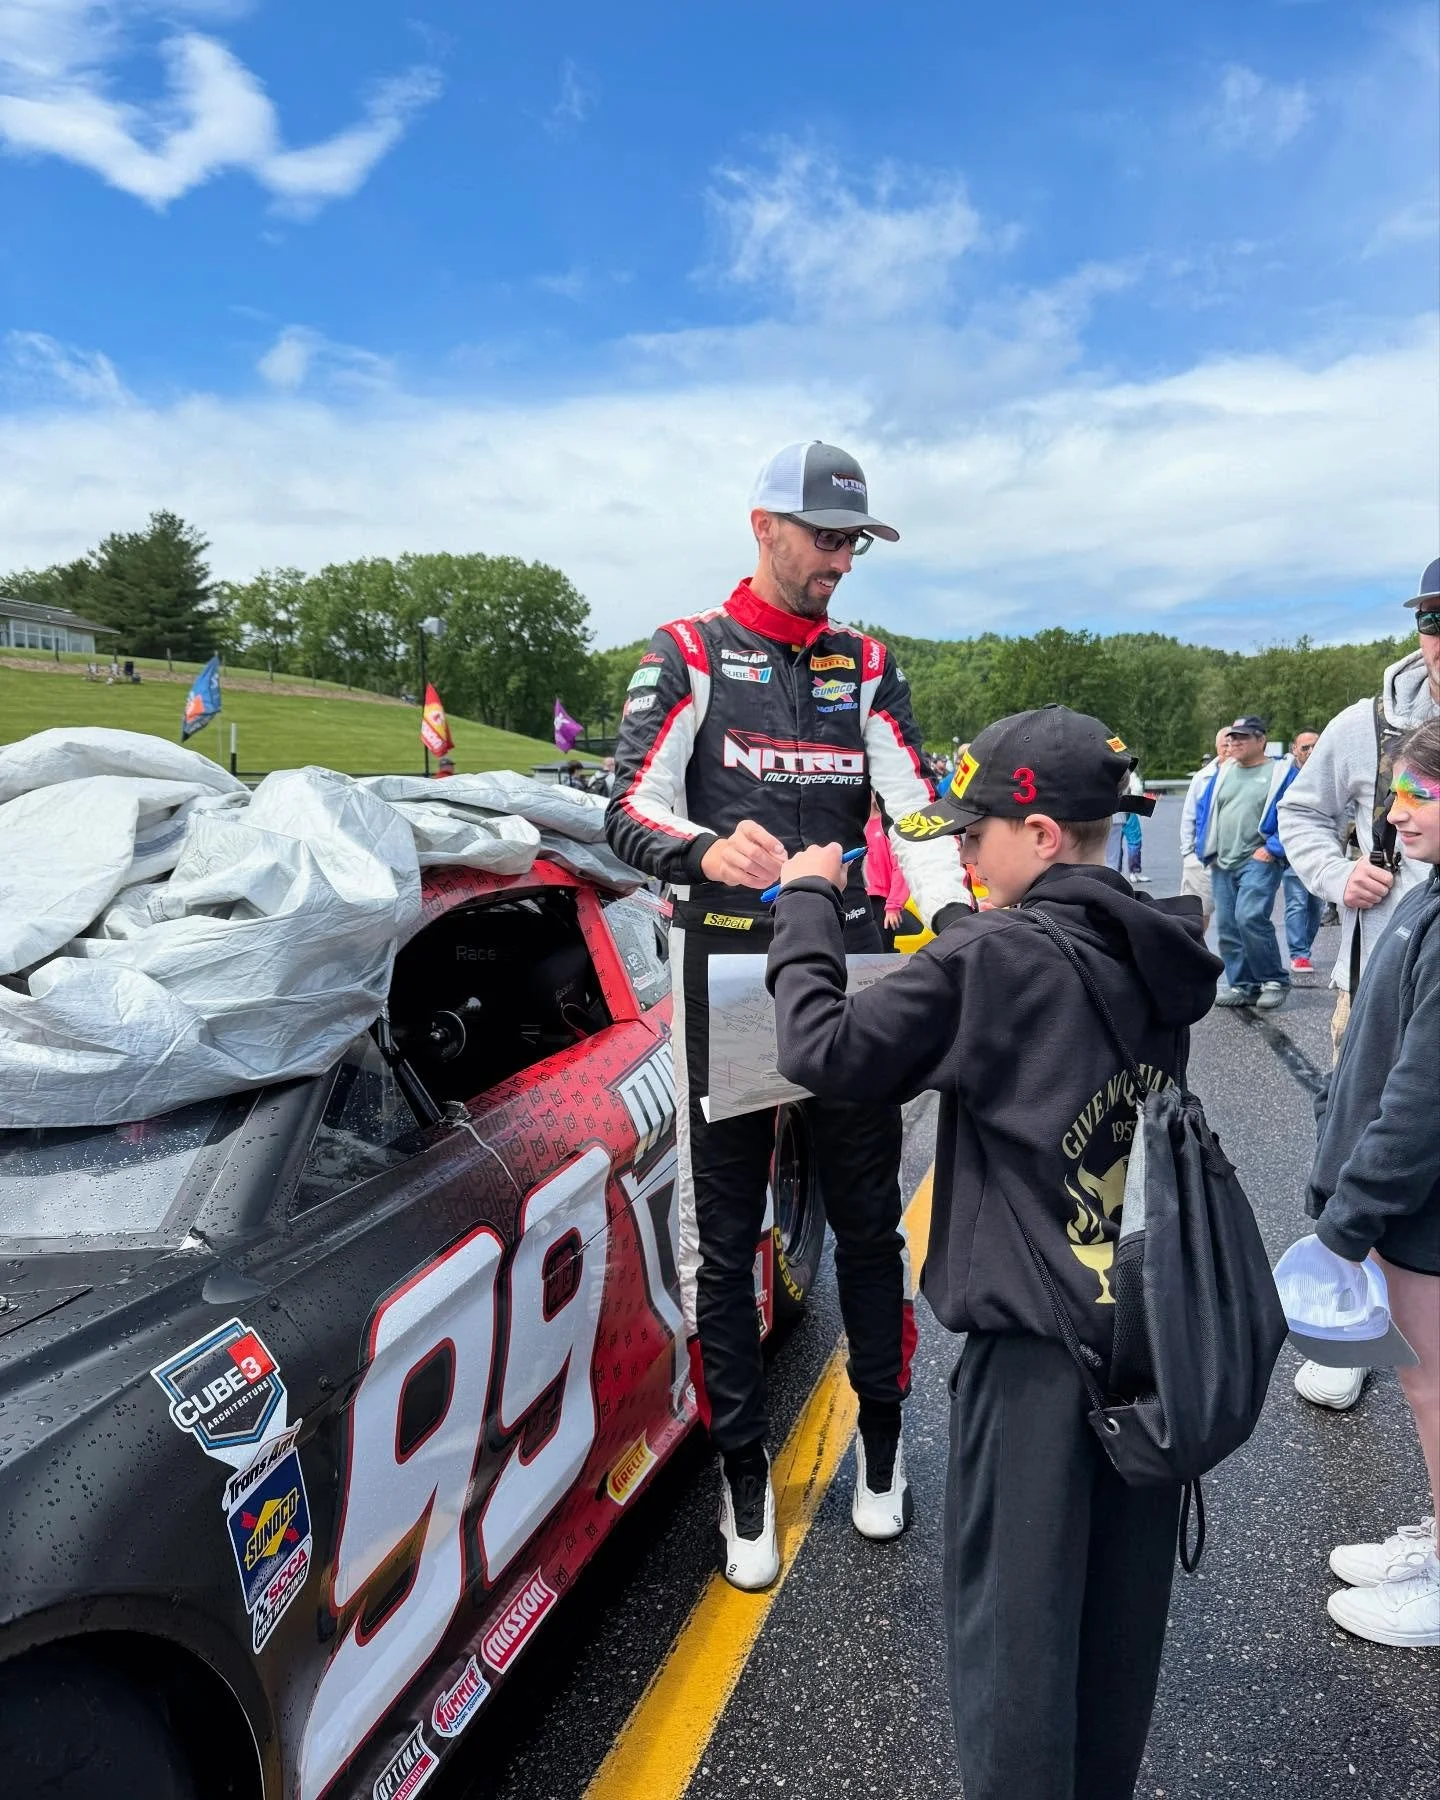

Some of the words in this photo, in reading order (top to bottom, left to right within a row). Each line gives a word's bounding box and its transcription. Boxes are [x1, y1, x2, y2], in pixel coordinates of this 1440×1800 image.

[814, 684, 853, 696] SUNOCO
[724, 733, 864, 781] NITRO
[763, 772, 864, 785] MOTORSPORTS
[1013, 768, 1037, 804] 3
[207, 1380, 269, 1430] ARCHITECTURE
[229, 1456, 268, 1504] Trans
[267, 1433, 295, 1468] Am
[611, 1441, 647, 1494] PIRELLI
[247, 1491, 297, 1566] SUNOCO
[268, 1548, 308, 1605] SCCA
[256, 1613, 273, 1646] PRO
[274, 1566, 306, 1616] RACING
[486, 1581, 548, 1662] MISSION
[435, 1667, 481, 1731] SUMMIT
[453, 1712, 469, 1730] RACING
[467, 1684, 487, 1712] EQUIPMENT
[378, 1739, 422, 1800] OPTIMA
[396, 1766, 424, 1800] BATTERIES
